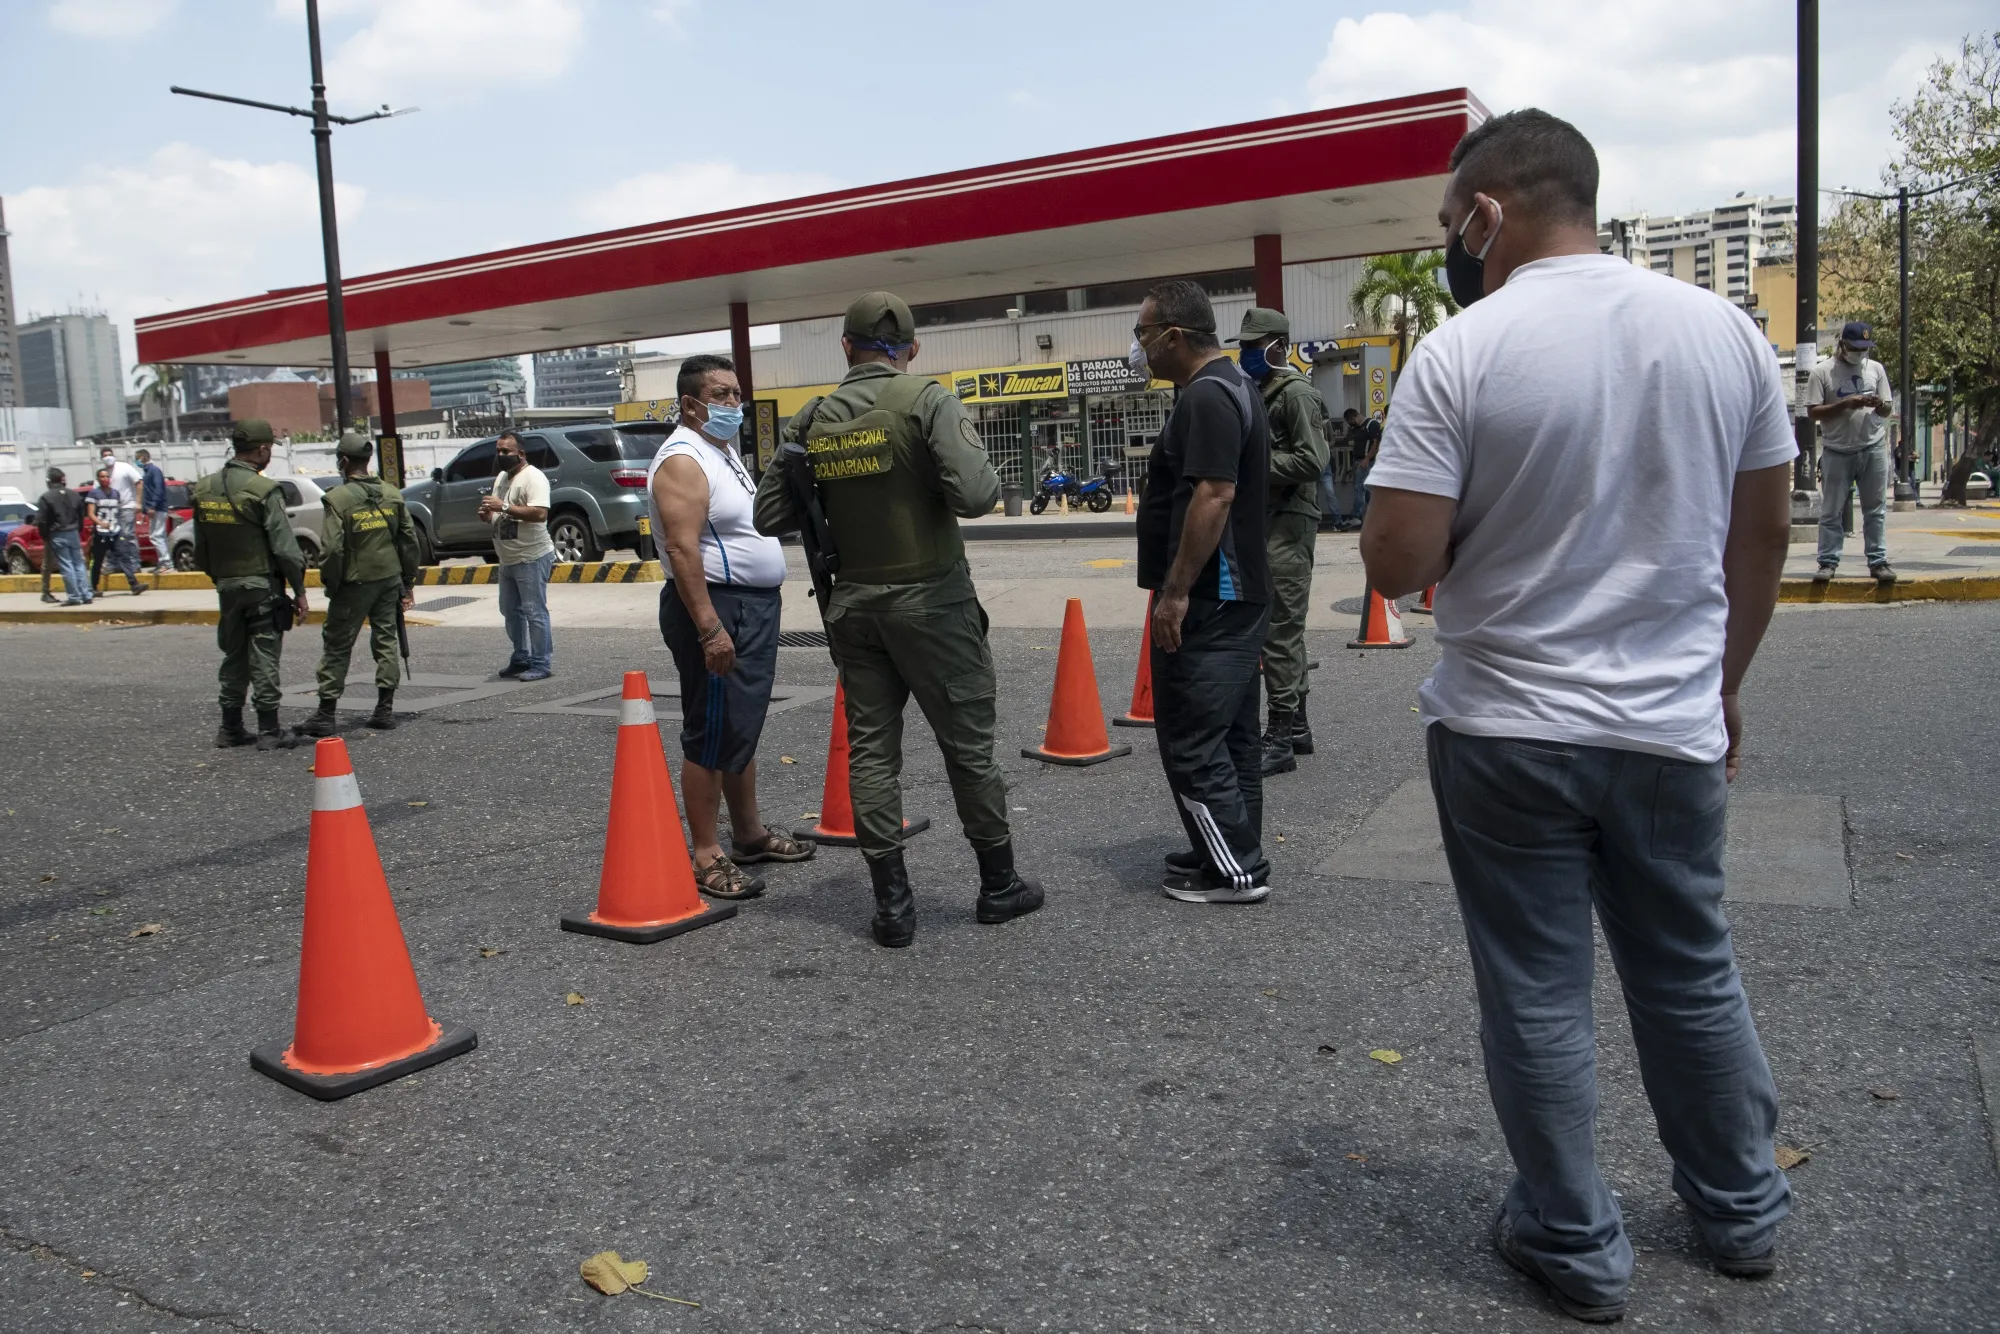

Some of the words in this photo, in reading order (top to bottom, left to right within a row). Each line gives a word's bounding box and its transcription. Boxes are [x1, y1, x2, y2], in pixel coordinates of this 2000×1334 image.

[1067, 363, 1080, 372] LA
[1082, 360, 1123, 371] PARADA
[1068, 372, 1081, 381] DE
[1083, 368, 1129, 380] IGNACIO
[1002, 373, 1063, 394] Duncan
[841, 428, 888, 450] NACIONAL
[814, 456, 880, 479] BOLIVARIANA
